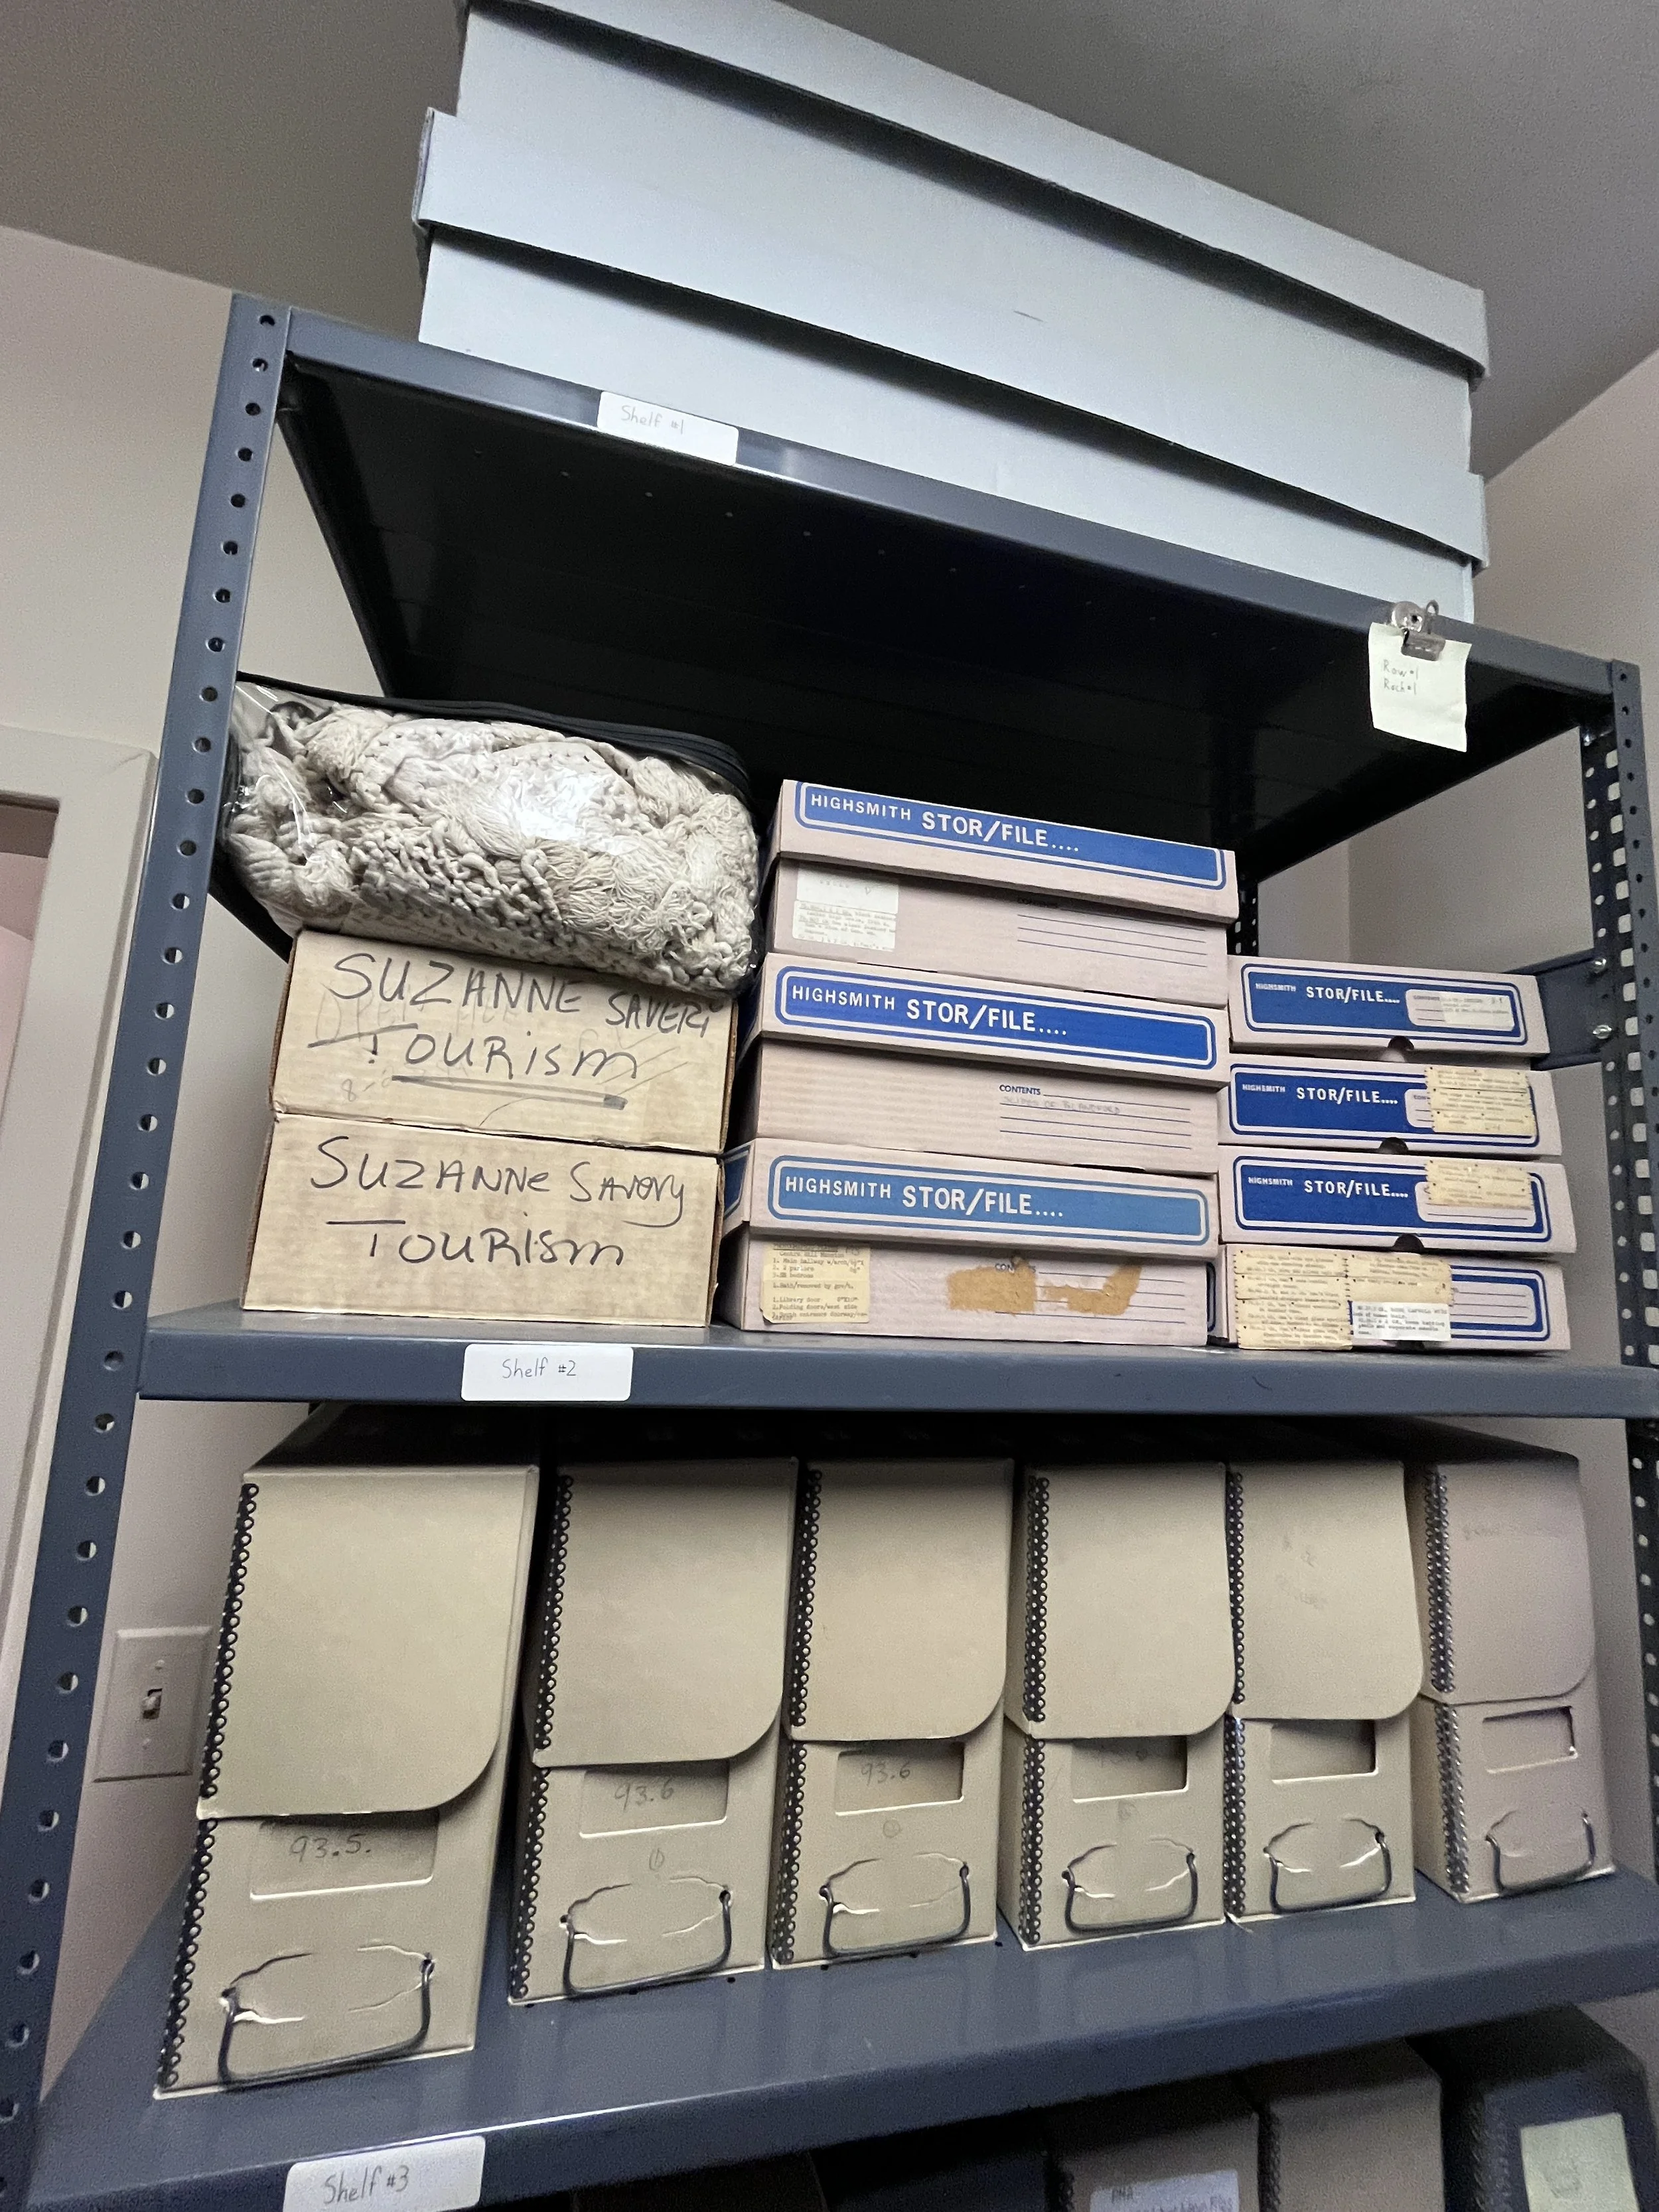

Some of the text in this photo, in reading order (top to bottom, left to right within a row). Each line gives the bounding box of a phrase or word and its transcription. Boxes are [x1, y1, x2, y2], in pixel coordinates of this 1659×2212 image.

[621, 404, 684, 435] Shelf #1
[811, 794, 912, 821] HIGHSMITH
[334, 952, 581, 1013] SUZANNE
[1256, 983, 1296, 992] HIGHSMITH
[792, 986, 895, 1010] HIGHSMITH
[999, 1084, 1041, 1095] CONTENTS
[1242, 1084, 1285, 1092] HIGHSMITH
[786, 1176, 891, 1199] HIGHSMITH
[1248, 1177, 1293, 1186] HIGHSMITH
[502, 1357, 577, 1379] Shelf #2
[614, 1776, 675, 1811] 93.6
[323, 2164, 410, 2205] Shelf #3
